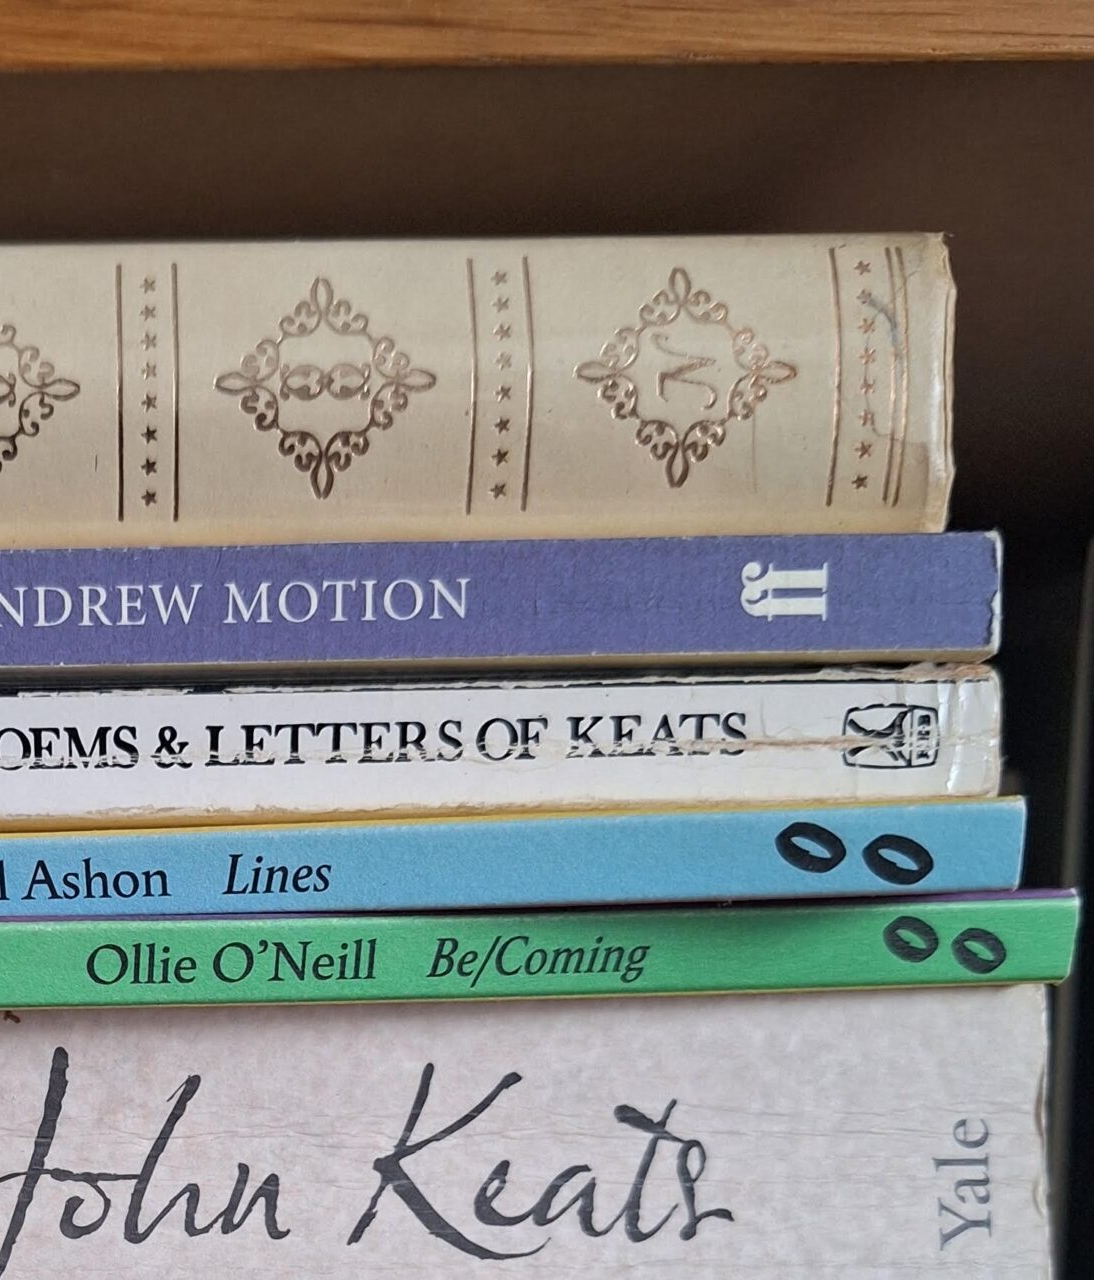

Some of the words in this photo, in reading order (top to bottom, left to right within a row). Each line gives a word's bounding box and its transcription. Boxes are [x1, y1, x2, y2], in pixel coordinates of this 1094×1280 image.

[222, 577, 472, 625] MOTION
[150, 725, 194, 770] &
[205, 719, 464, 767] LETTERS
[475, 715, 549, 761] OF
[565, 711, 749, 759] KEATS
[21, 856, 172, 901] Ashon
[222, 852, 332, 896] Lines
[86, 940, 197, 986] Ollie
[212, 937, 377, 983] O'Neill
[425, 935, 651, 989] Be/Coming
[347, 1061, 734, 1260] Keats
[939, 1115, 992, 1253] Yale
